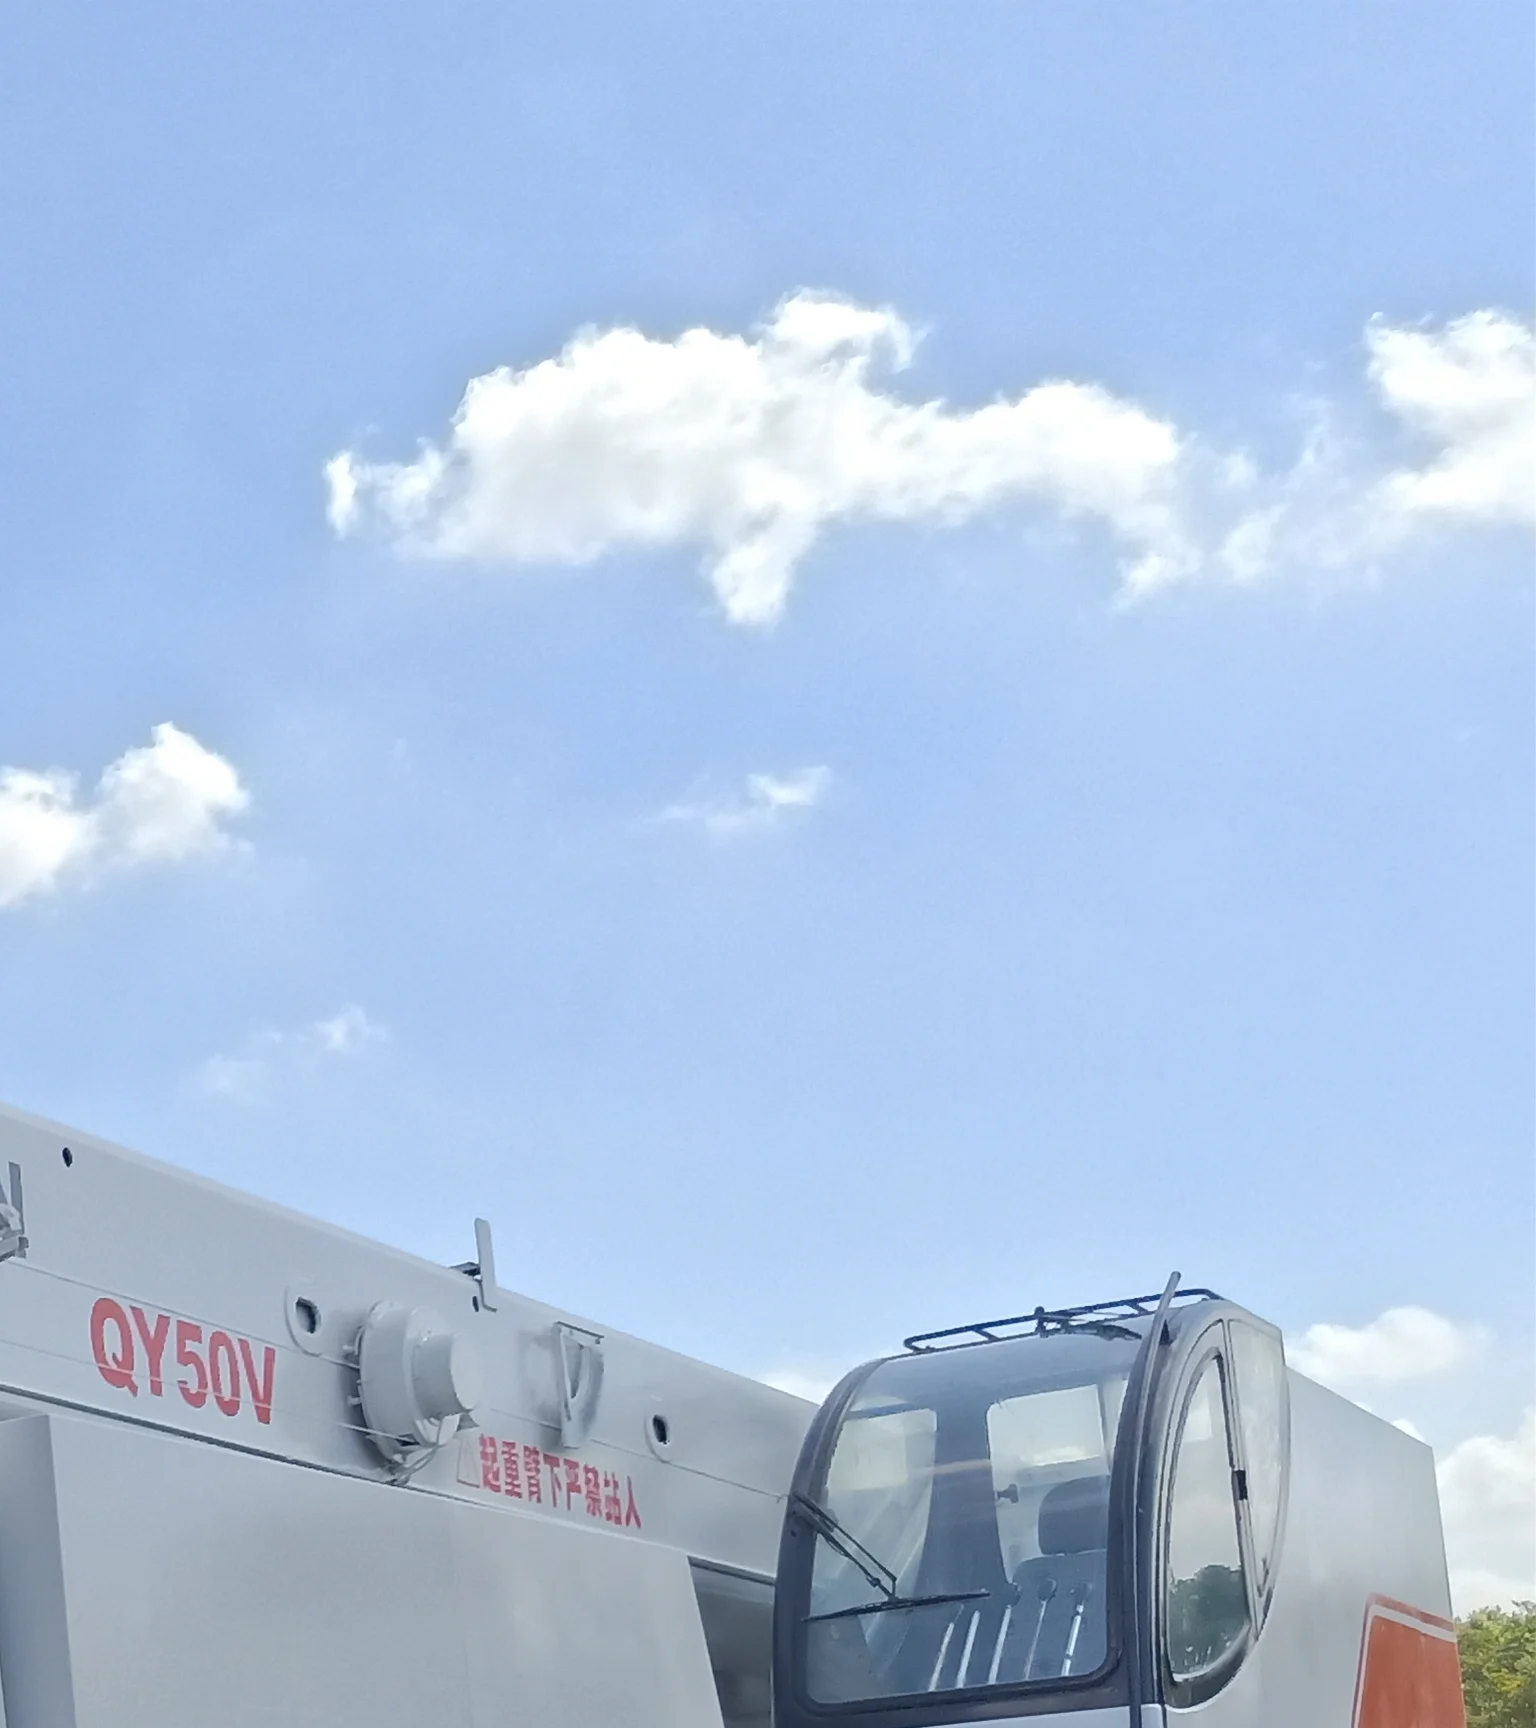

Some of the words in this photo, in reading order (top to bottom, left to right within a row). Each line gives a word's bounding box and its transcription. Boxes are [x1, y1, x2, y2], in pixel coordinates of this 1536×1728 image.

[90, 1297, 276, 1425] QY50V
[479, 1433, 642, 1529] 起重臂下严禁站人
